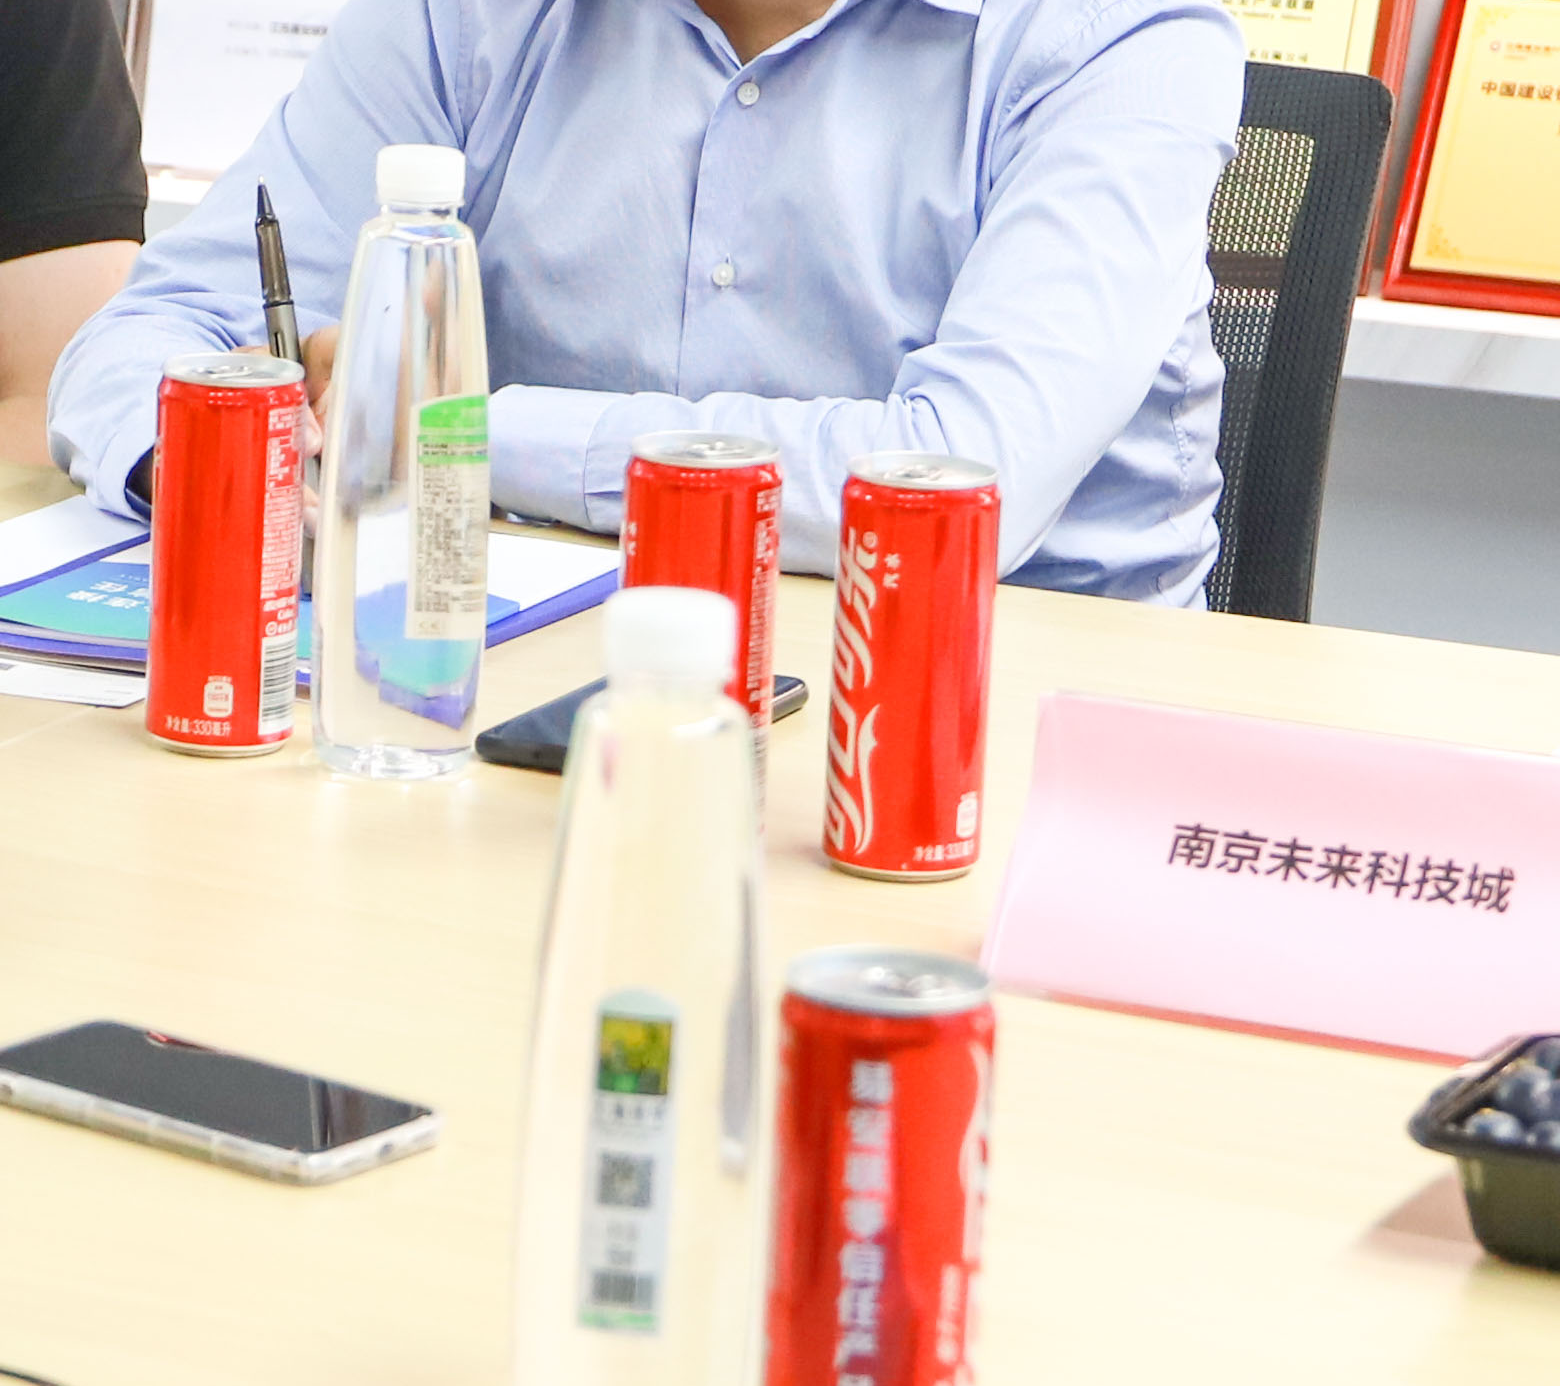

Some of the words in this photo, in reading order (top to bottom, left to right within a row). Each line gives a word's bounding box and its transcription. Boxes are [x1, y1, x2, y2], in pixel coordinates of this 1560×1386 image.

[1167, 822, 1516, 914] 南京未来科技城
